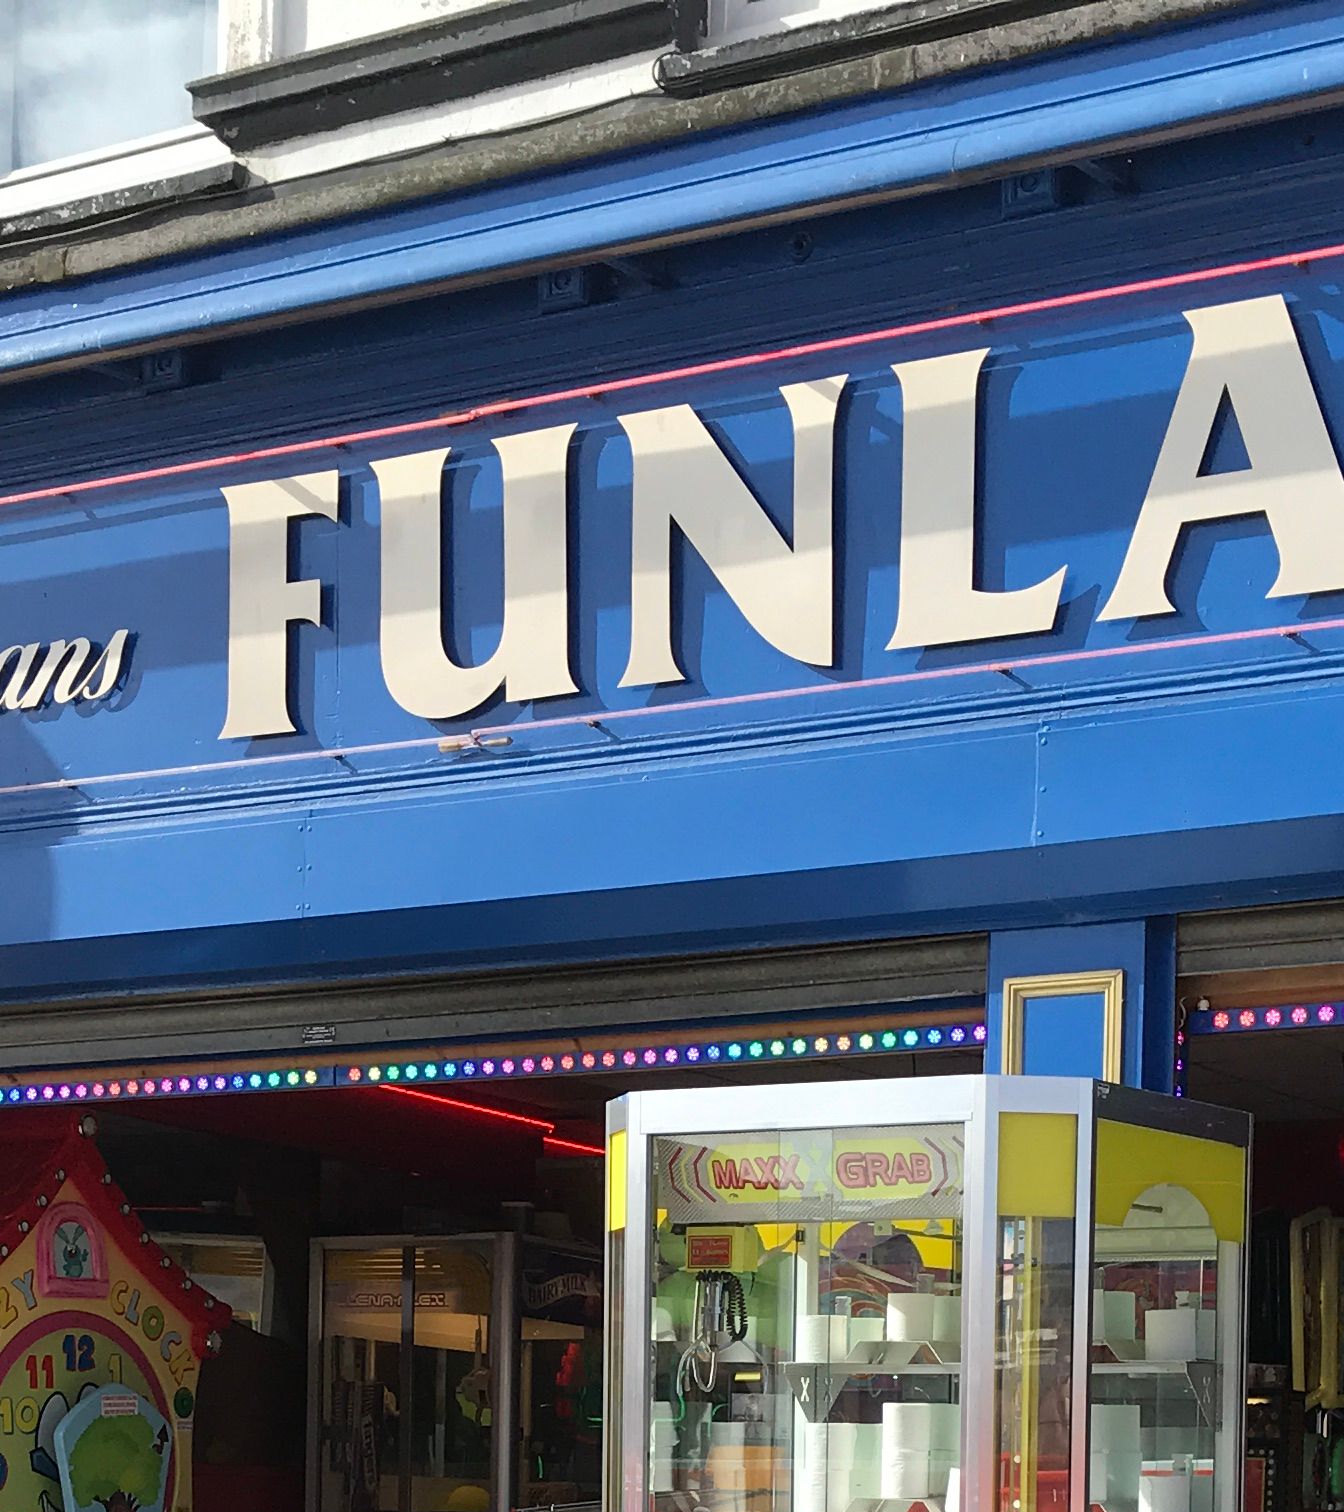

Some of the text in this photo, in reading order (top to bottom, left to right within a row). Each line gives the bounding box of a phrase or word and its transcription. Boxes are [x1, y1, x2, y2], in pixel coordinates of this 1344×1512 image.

[712, 1151, 933, 1191] MAXX GRAB
[110, 1279, 196, 1387] CLOCK
[25, 1354, 54, 1389] 11
[62, 1334, 96, 1372] 12
[107, 1353, 123, 1384] 1
